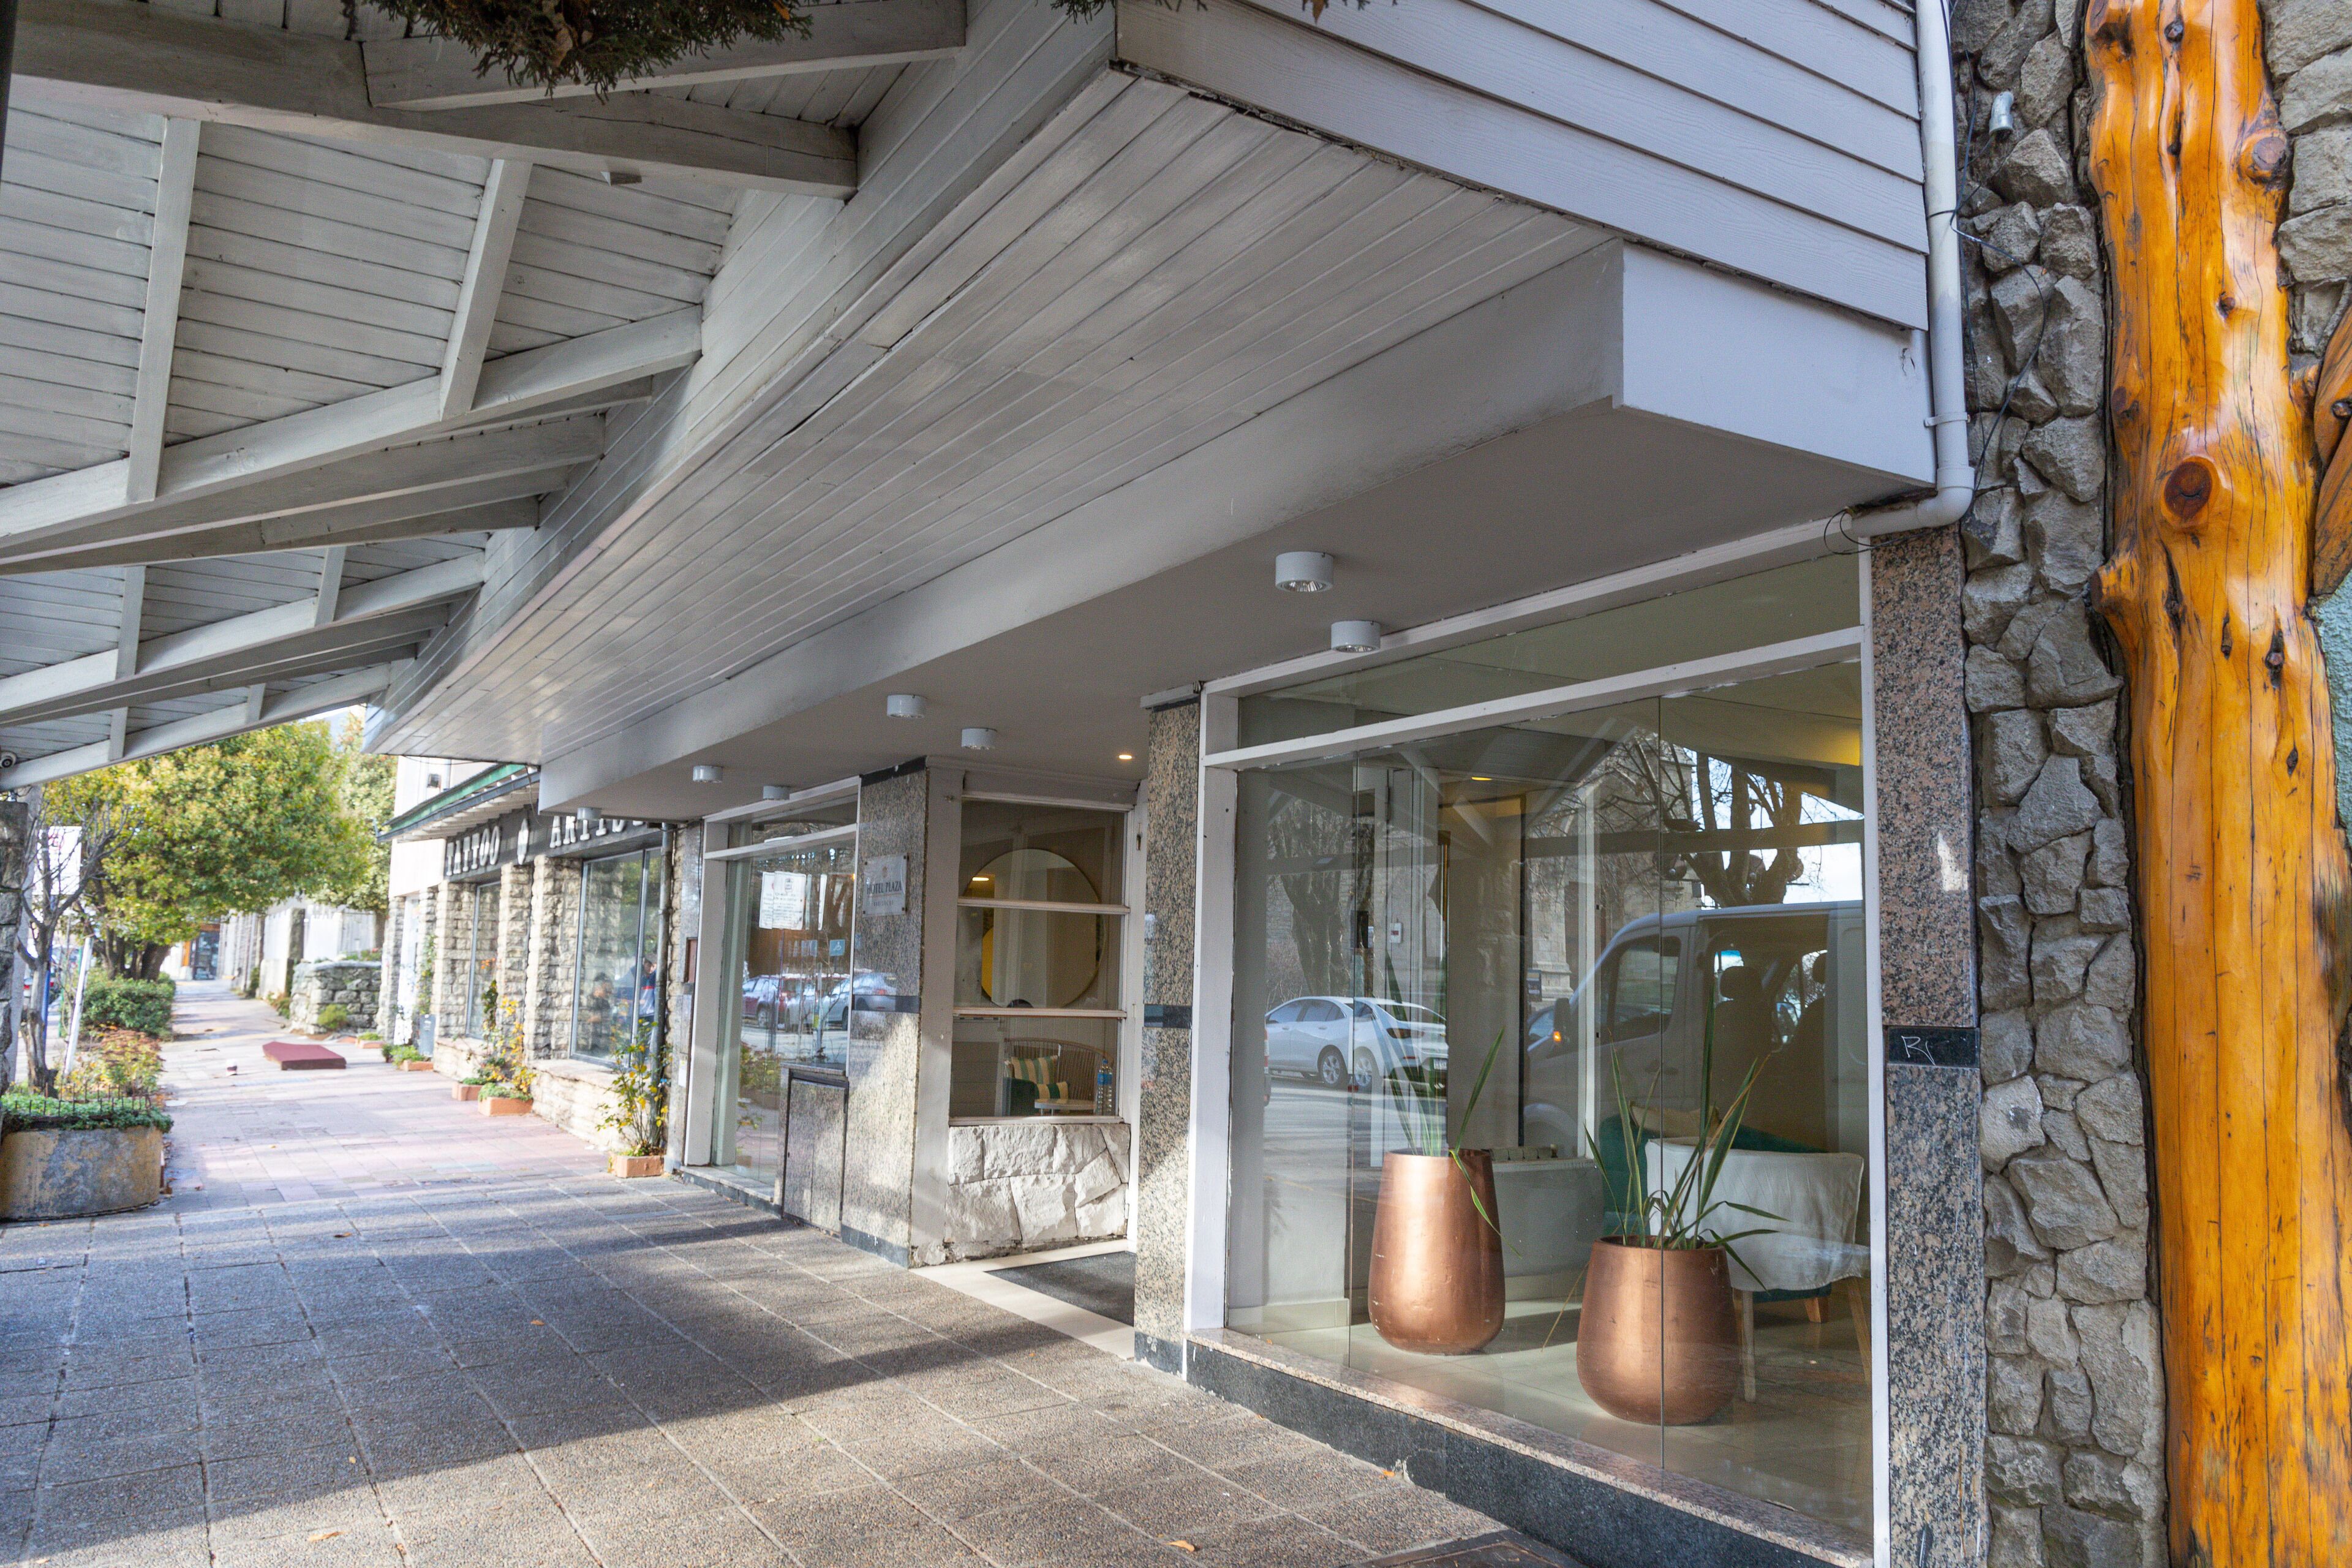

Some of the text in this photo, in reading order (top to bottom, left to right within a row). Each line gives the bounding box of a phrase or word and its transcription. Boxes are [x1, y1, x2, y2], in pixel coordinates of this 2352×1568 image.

[446, 826, 500, 876] TATTOO
[867, 881, 902, 894] HOTEL PLAZA
